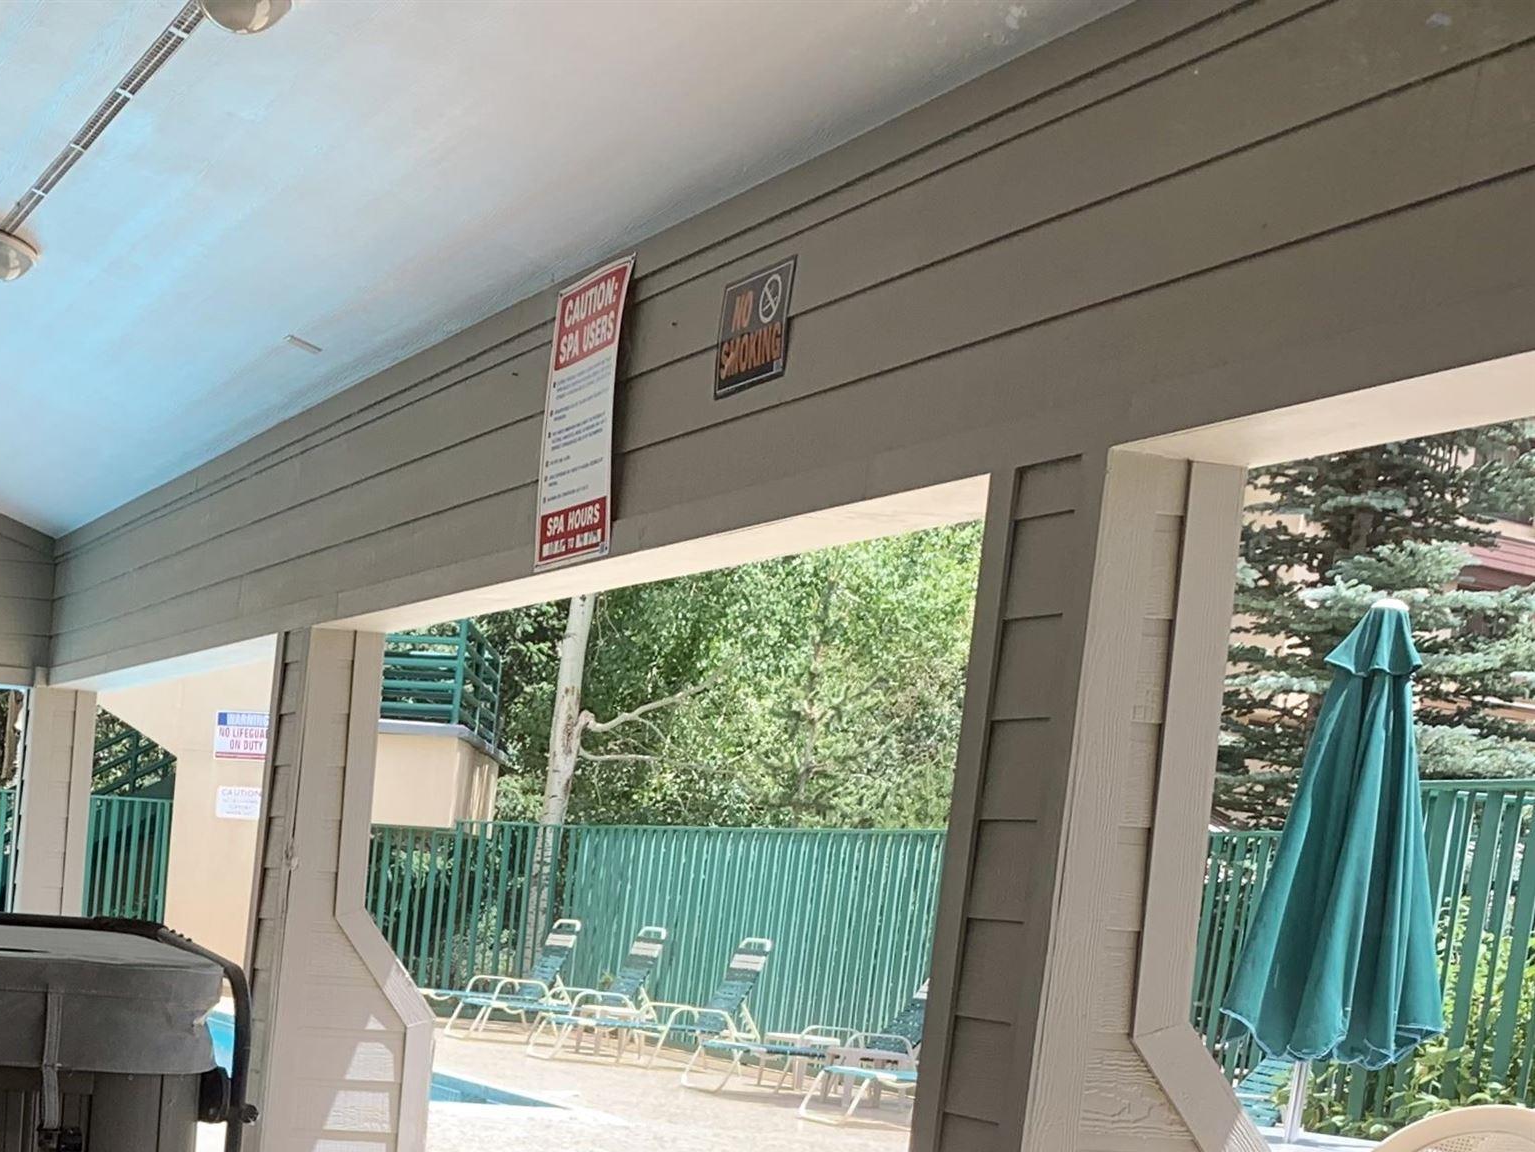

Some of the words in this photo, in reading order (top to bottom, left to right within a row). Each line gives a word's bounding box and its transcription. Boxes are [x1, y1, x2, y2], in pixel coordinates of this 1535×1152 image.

[565, 276, 619, 328] CAUTION:
[731, 290, 754, 333] NO
[559, 330, 580, 364] SPA
[582, 310, 616, 352] USERS
[720, 321, 782, 380] SMOKING
[546, 514, 565, 537] SPA
[567, 503, 601, 531] HOURS
[219, 727, 230, 738] NO
[229, 739, 241, 750] ON
[243, 740, 264, 750] DUTY
